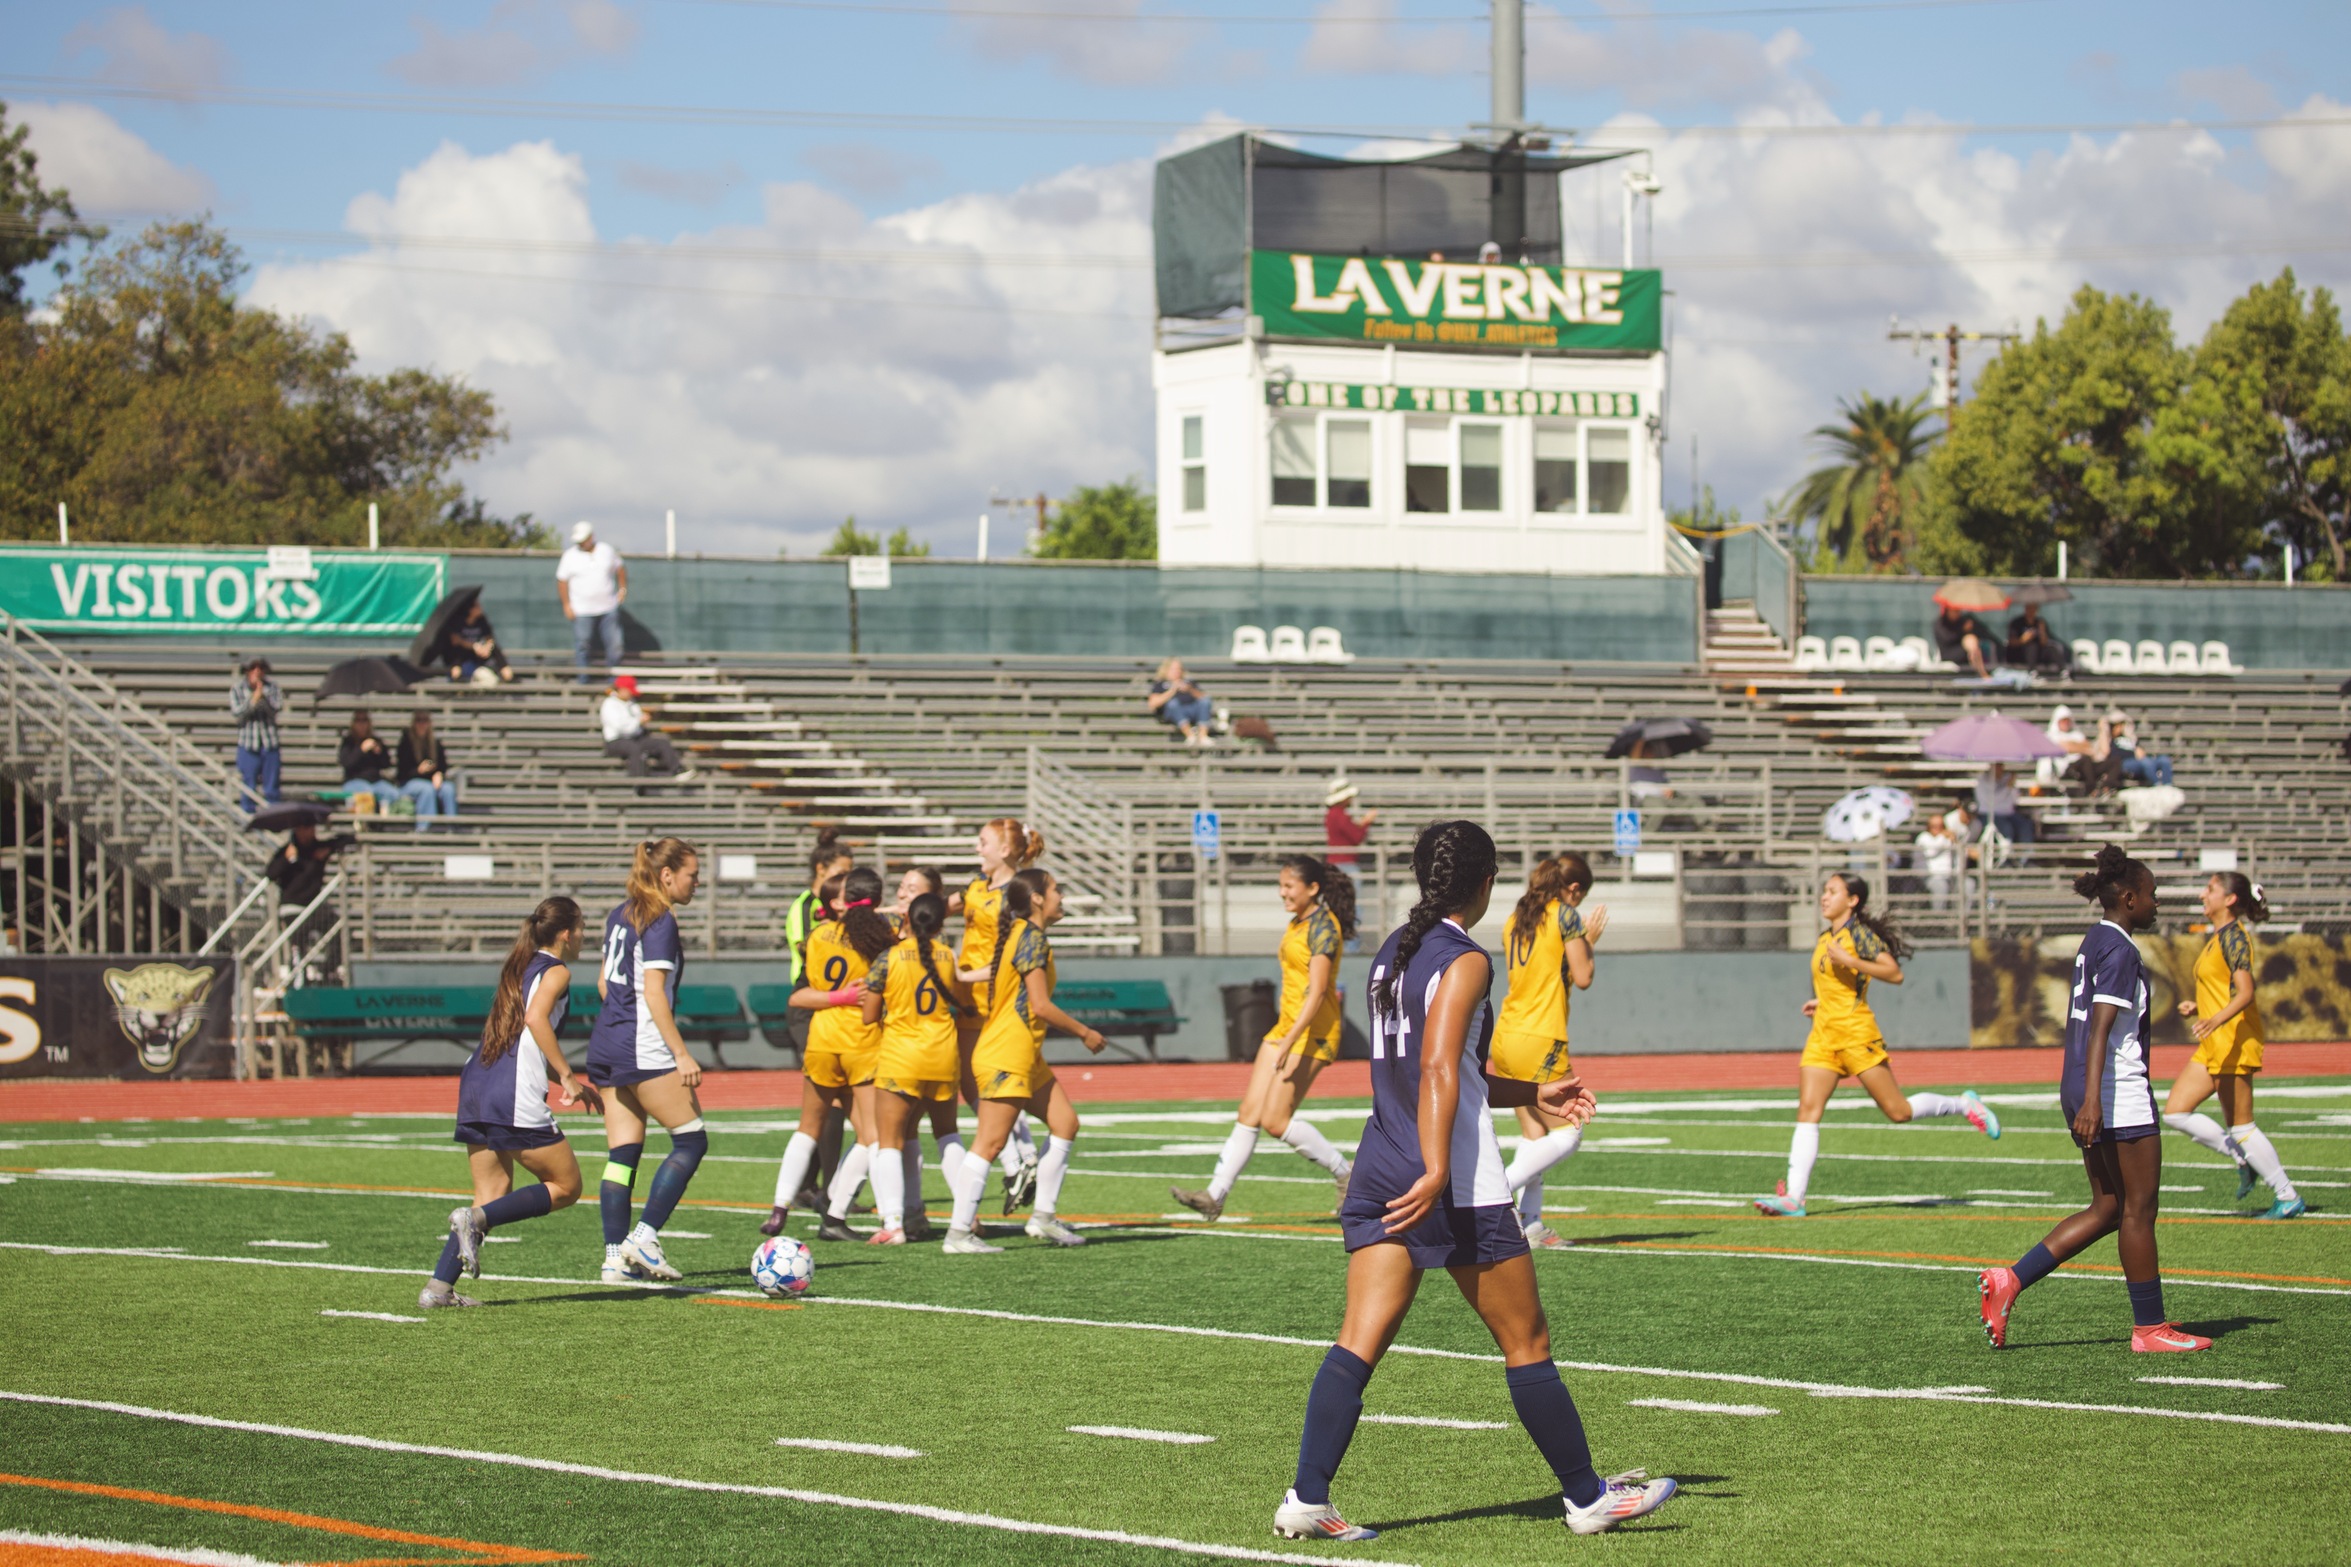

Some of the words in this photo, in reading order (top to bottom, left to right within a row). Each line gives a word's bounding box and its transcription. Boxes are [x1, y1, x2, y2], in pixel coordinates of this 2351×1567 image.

[1284, 381, 1349, 408] OME
[1361, 384, 1399, 411] OF
[1411, 387, 1470, 413] THE
[1482, 388, 1635, 417] LEOPARDS
[604, 923, 628, 986] 12
[824, 955, 848, 992] 9
[915, 973, 938, 1016] 6
[1370, 964, 1411, 1059] 14
[44, 1045, 70, 1064] TM
